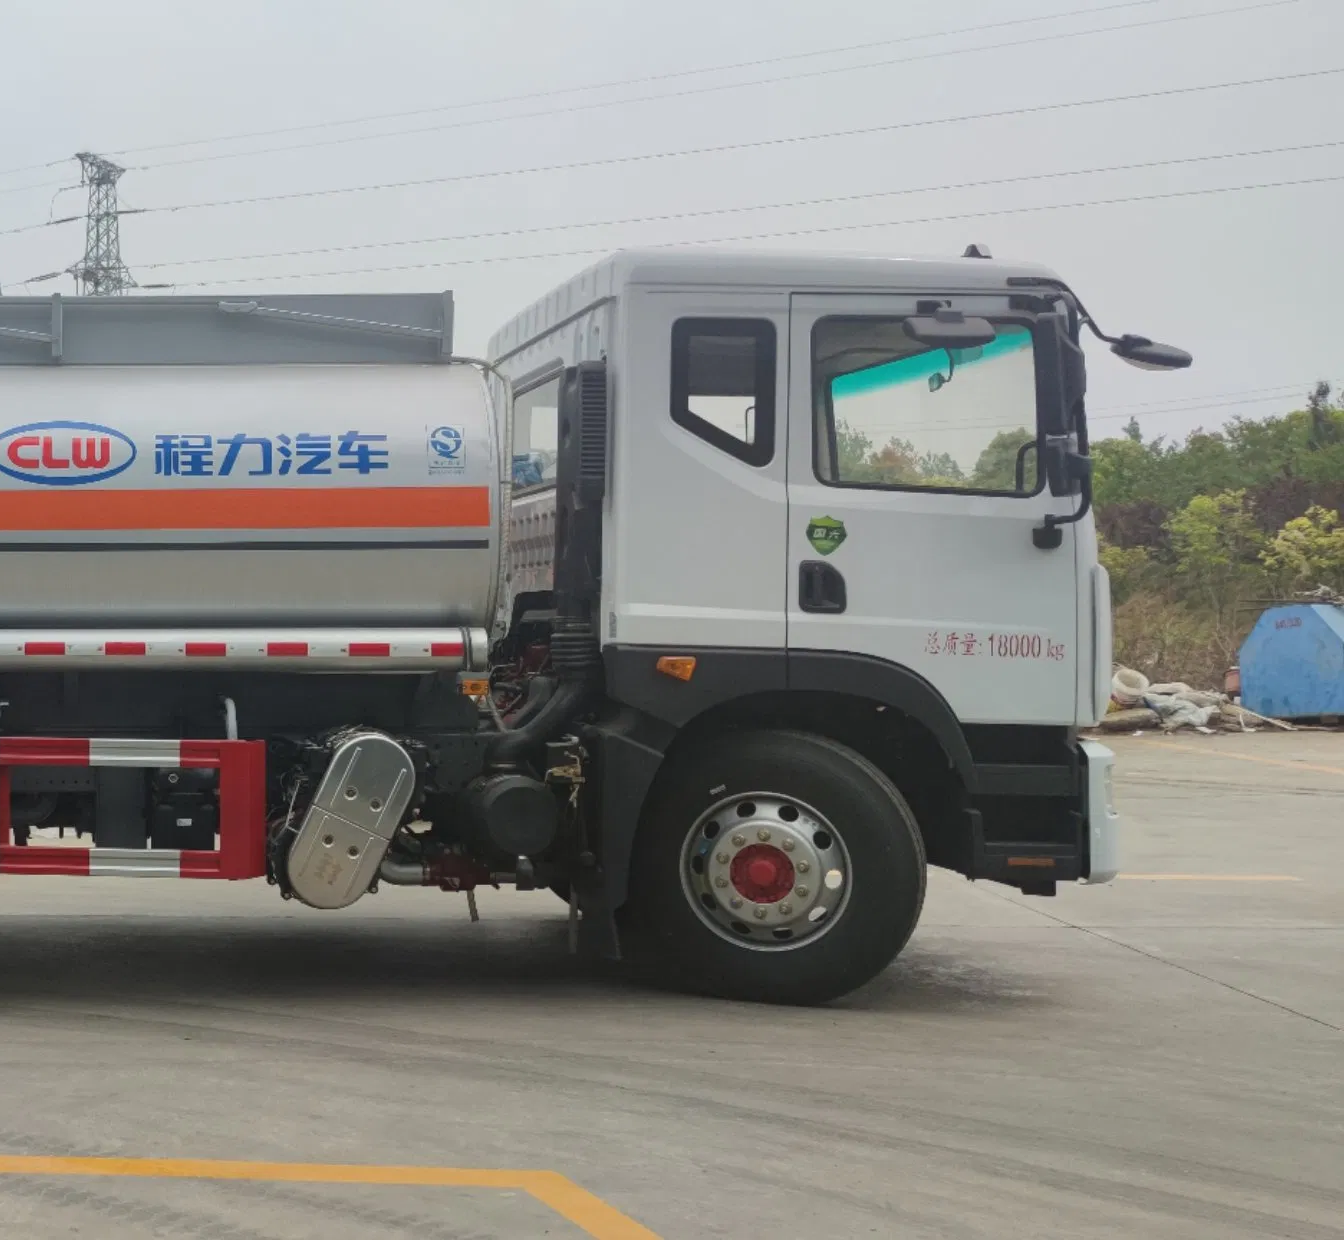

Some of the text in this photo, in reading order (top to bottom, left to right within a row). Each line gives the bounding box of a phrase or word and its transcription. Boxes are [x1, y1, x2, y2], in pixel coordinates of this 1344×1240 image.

[7, 436, 110, 469] CLW
[155, 431, 388, 476] 程力汽车
